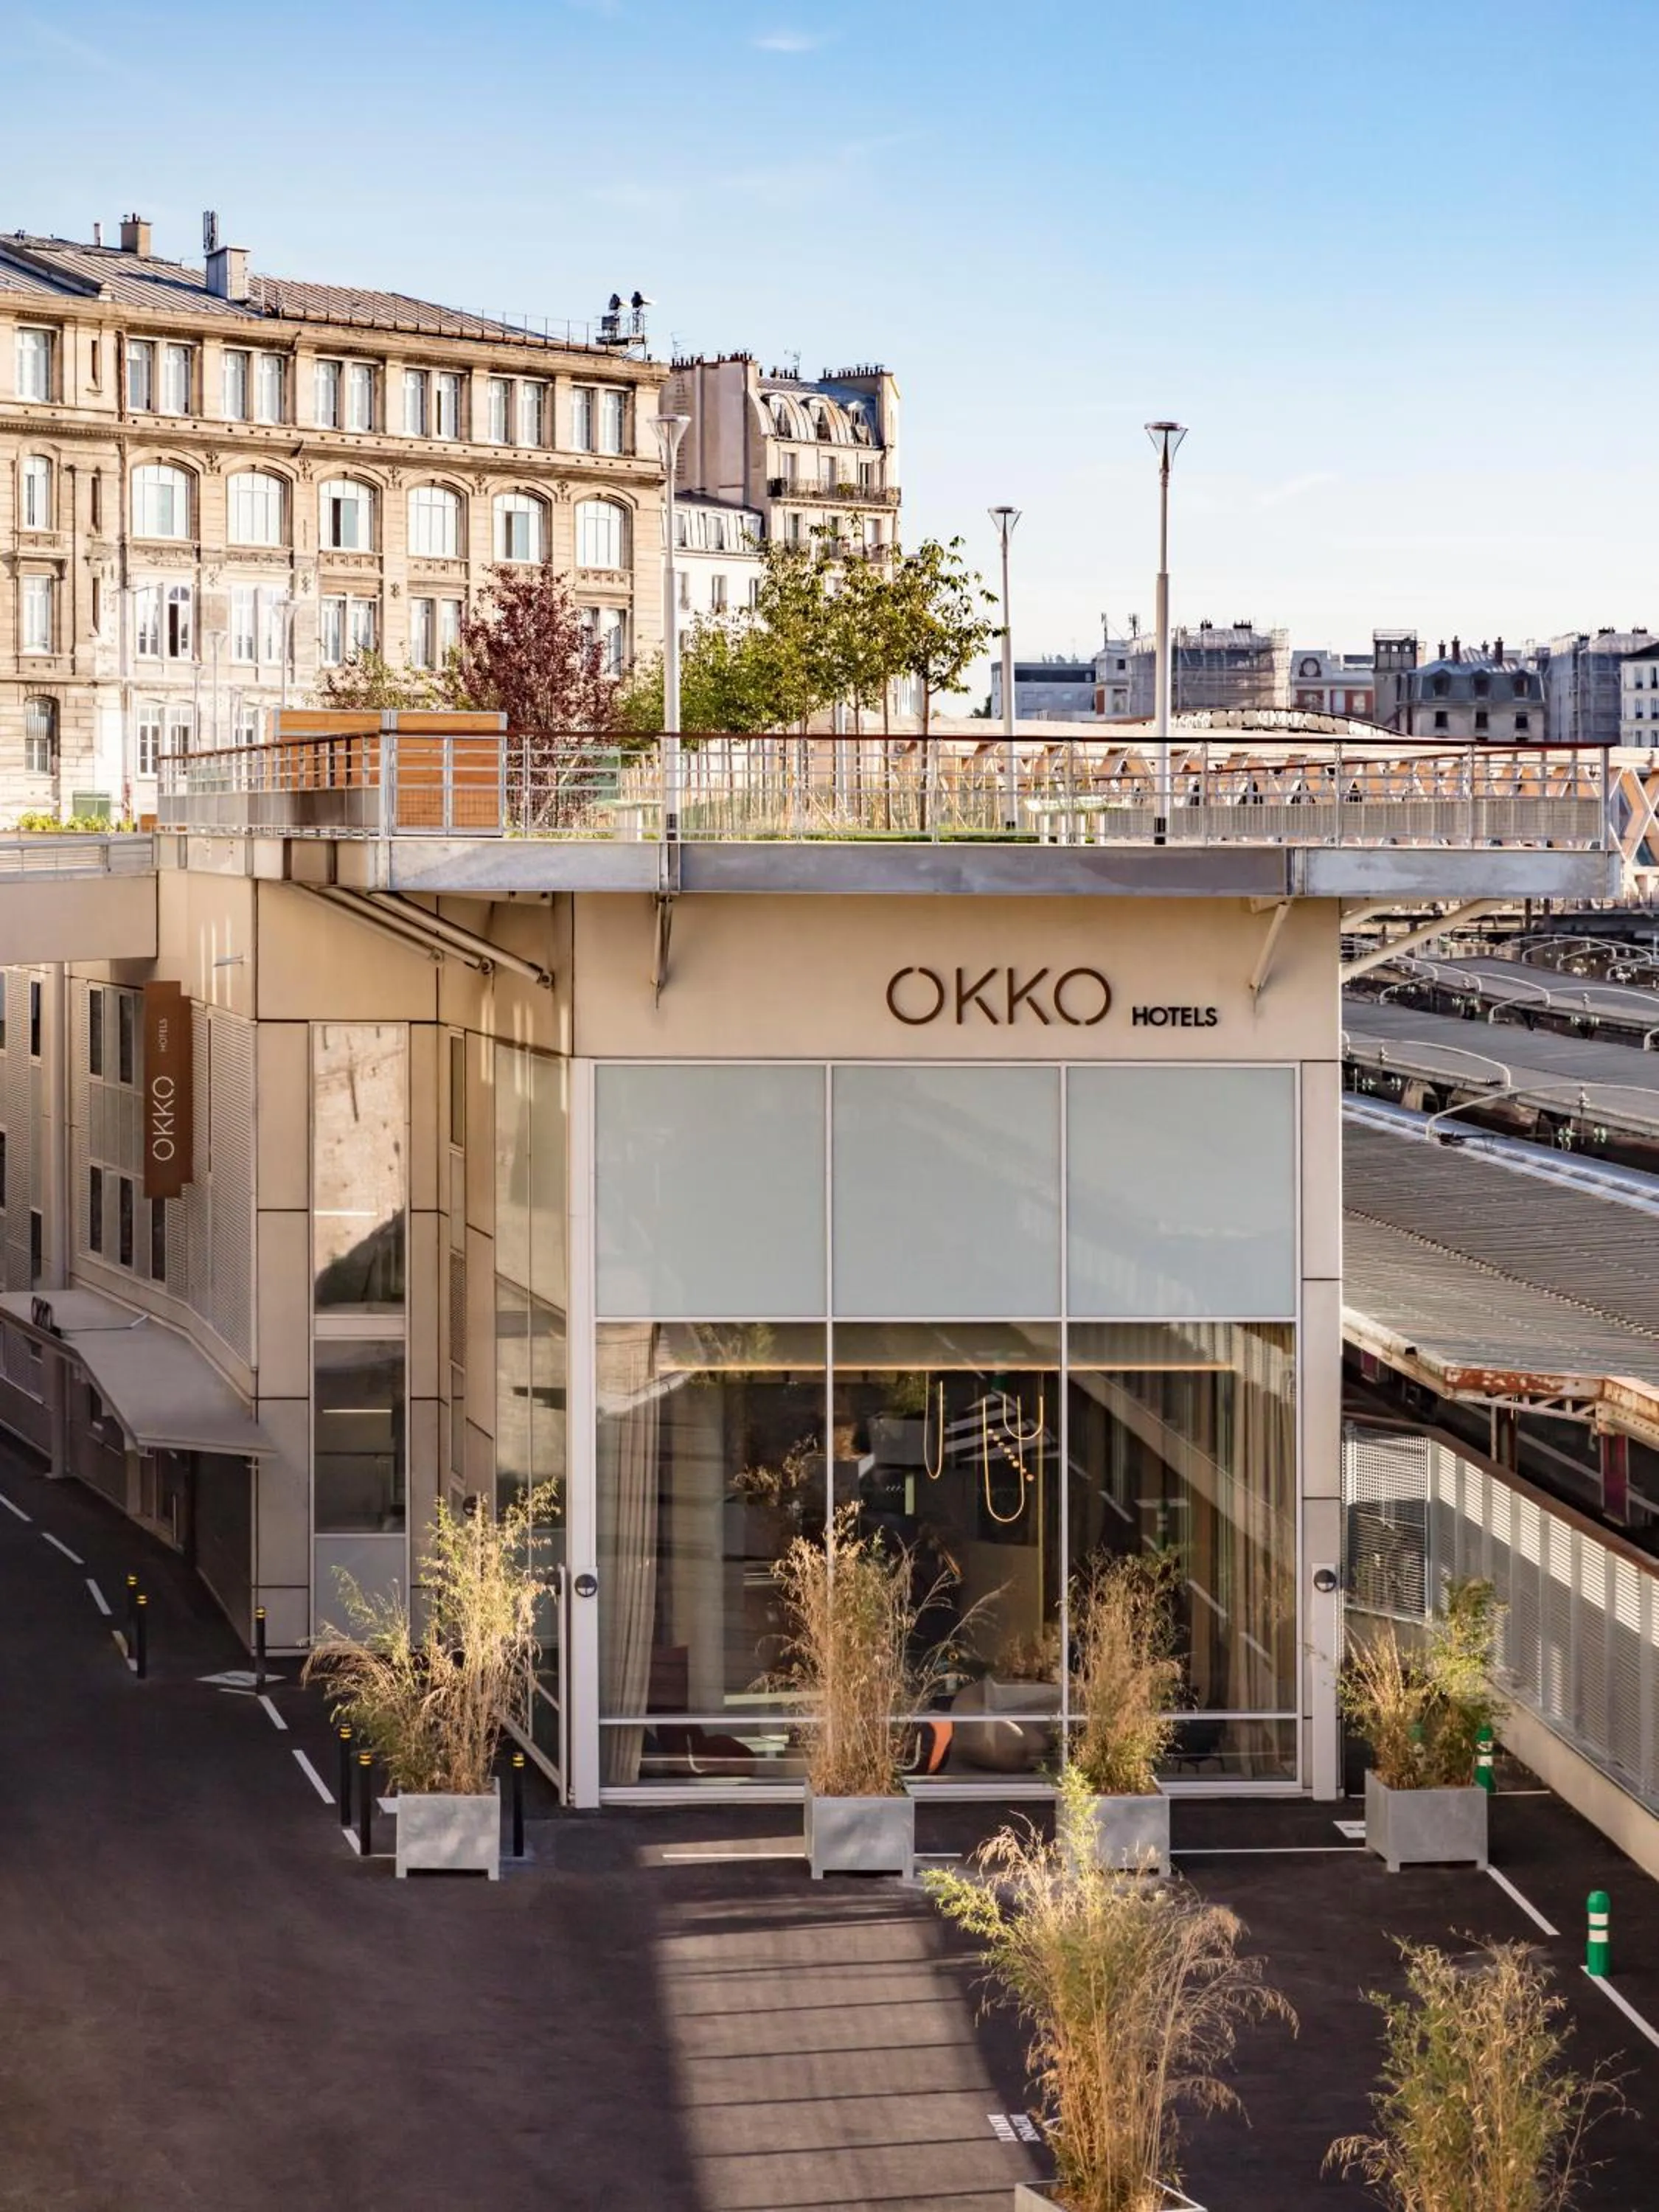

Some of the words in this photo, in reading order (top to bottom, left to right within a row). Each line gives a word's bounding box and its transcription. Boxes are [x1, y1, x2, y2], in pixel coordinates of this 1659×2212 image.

[886, 967, 1112, 1025] OKKO
[1132, 1006, 1218, 1027] HOTELS
[159, 1018, 168, 1052] HOTELS
[152, 1076, 175, 1161] OKKO
